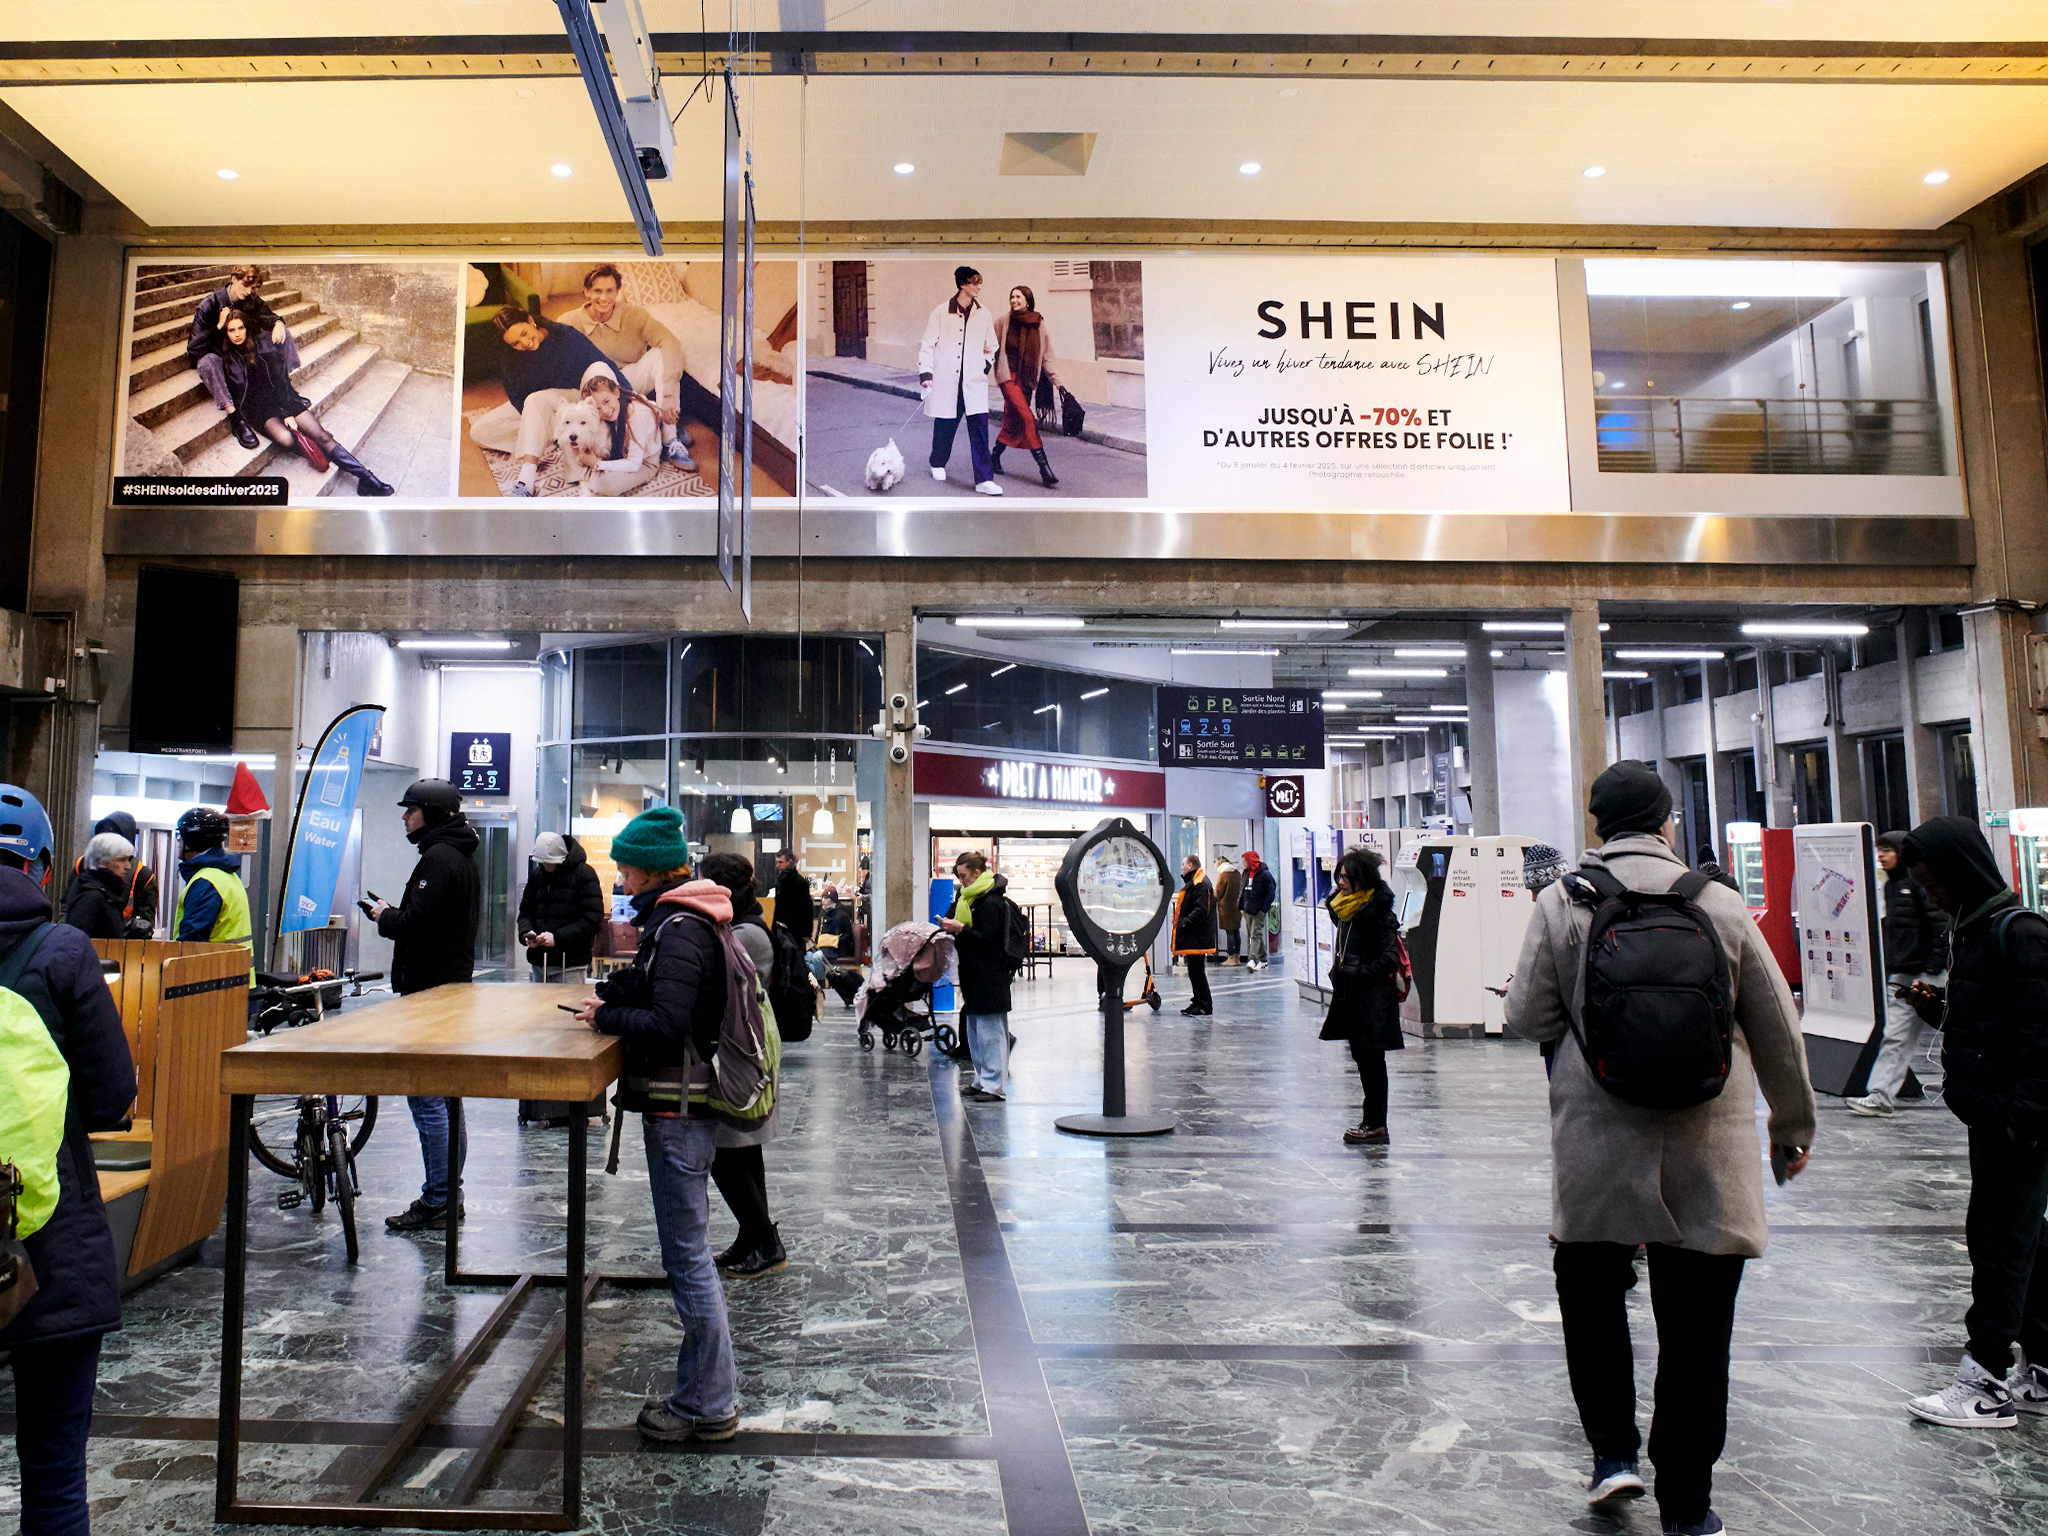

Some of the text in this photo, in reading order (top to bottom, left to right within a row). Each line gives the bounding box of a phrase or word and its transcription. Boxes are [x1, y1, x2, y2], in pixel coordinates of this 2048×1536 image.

[1257, 300, 1446, 340] SHEIN
[1209, 346, 1495, 380] Vivez un hiver tendance avec SHEIN
[1258, 403, 1452, 427] JUSQU'À -70% ET
[1203, 428, 1310, 448] D'AUTRES
[1315, 431, 1398, 449] OFFRES
[1403, 432, 1431, 449] DE
[1437, 432, 1495, 450] FOLIE
[1233, 461, 1239, 469] 8
[1240, 461, 1268, 471] janvier
[1371, 462, 1408, 470] sélection
[1410, 462, 1446, 471] d'articles
[1448, 463, 1496, 472] uniquement
[1308, 471, 1406, 479] Photographie retouchée
[122, 484, 280, 496] #SHEINsoldesdhiver2025
[1242, 694, 1285, 703] Sortie Nord
[1200, 723, 1208, 734] 2
[1223, 723, 1231, 734] 9
[1196, 740, 1235, 748] Sortie Sud
[464, 775, 472, 788] 2
[488, 775, 497, 788] 9
[1001, 760, 1103, 803] PRET A MANGER
[1276, 790, 1294, 803] PRET
[309, 809, 341, 833] Eau
[304, 831, 338, 849] Water
[1359, 833, 1377, 844] ICI,
